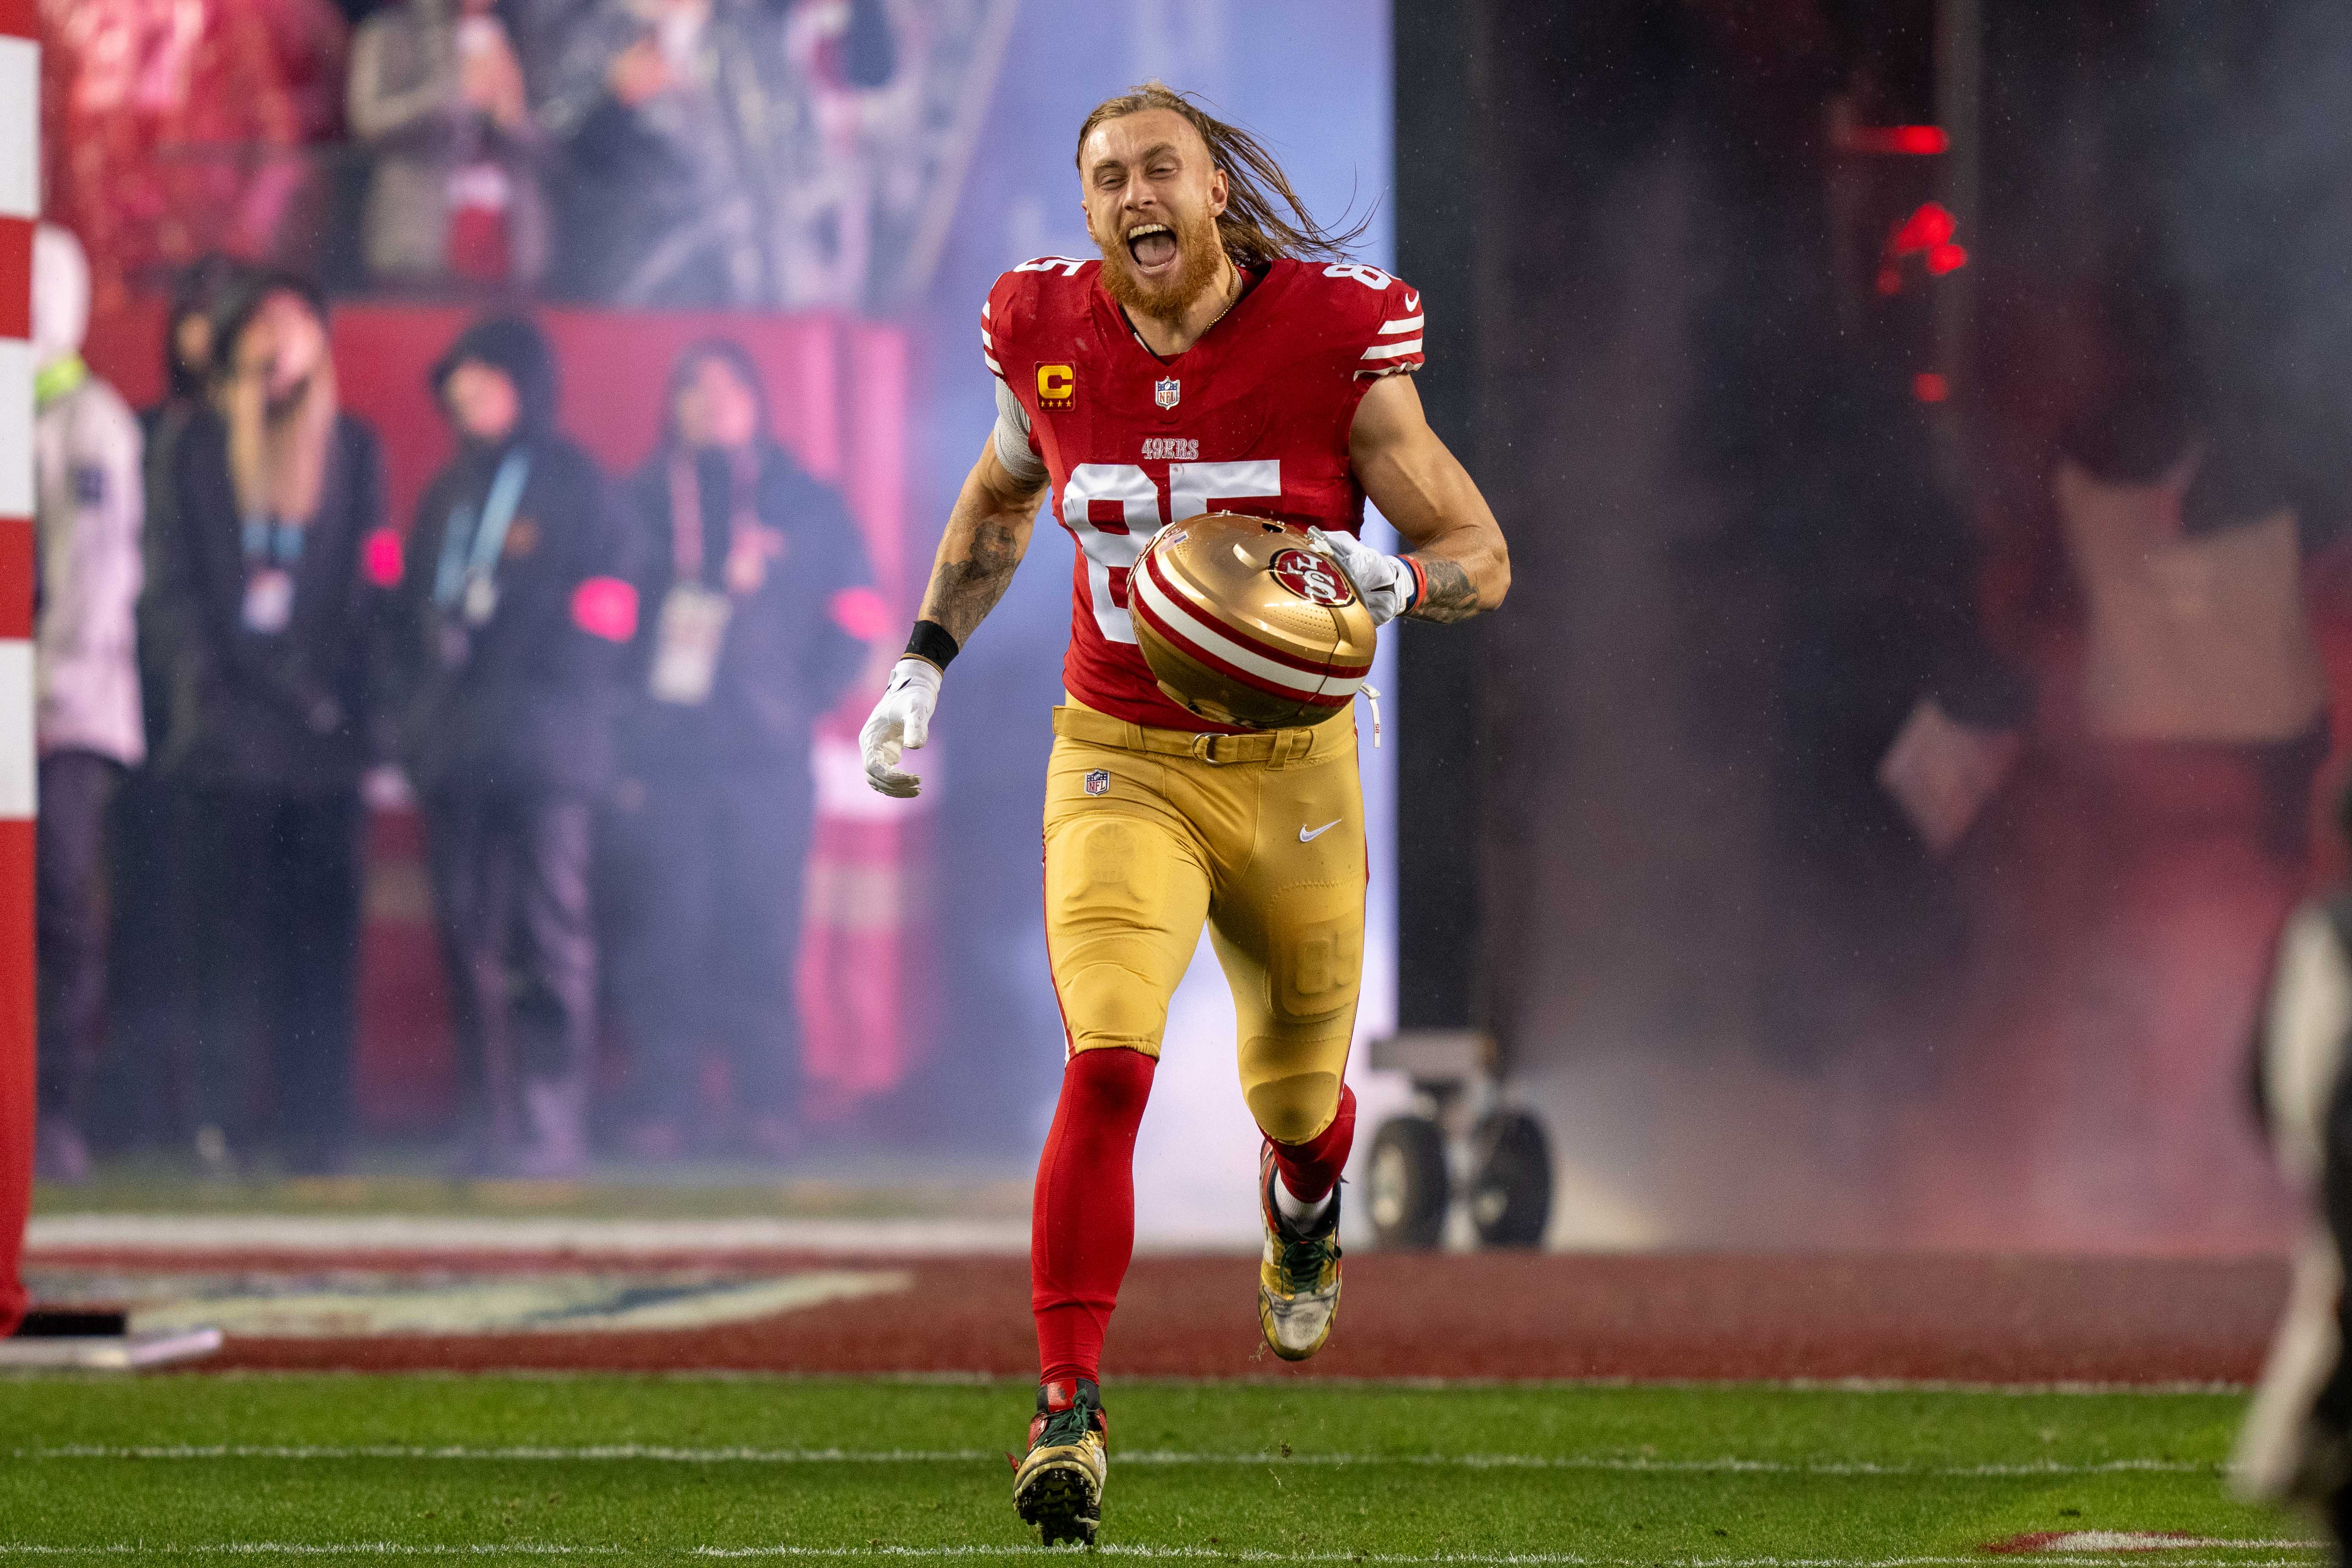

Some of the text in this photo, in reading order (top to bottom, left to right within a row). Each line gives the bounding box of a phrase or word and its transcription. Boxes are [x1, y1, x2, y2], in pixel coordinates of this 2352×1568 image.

[1322, 263, 1402, 290] 8
[1037, 365, 1073, 399] C
[1159, 391, 1175, 404] NFL
[1141, 438, 1199, 460] 49ERS
[1089, 781, 1106, 792] NFL
